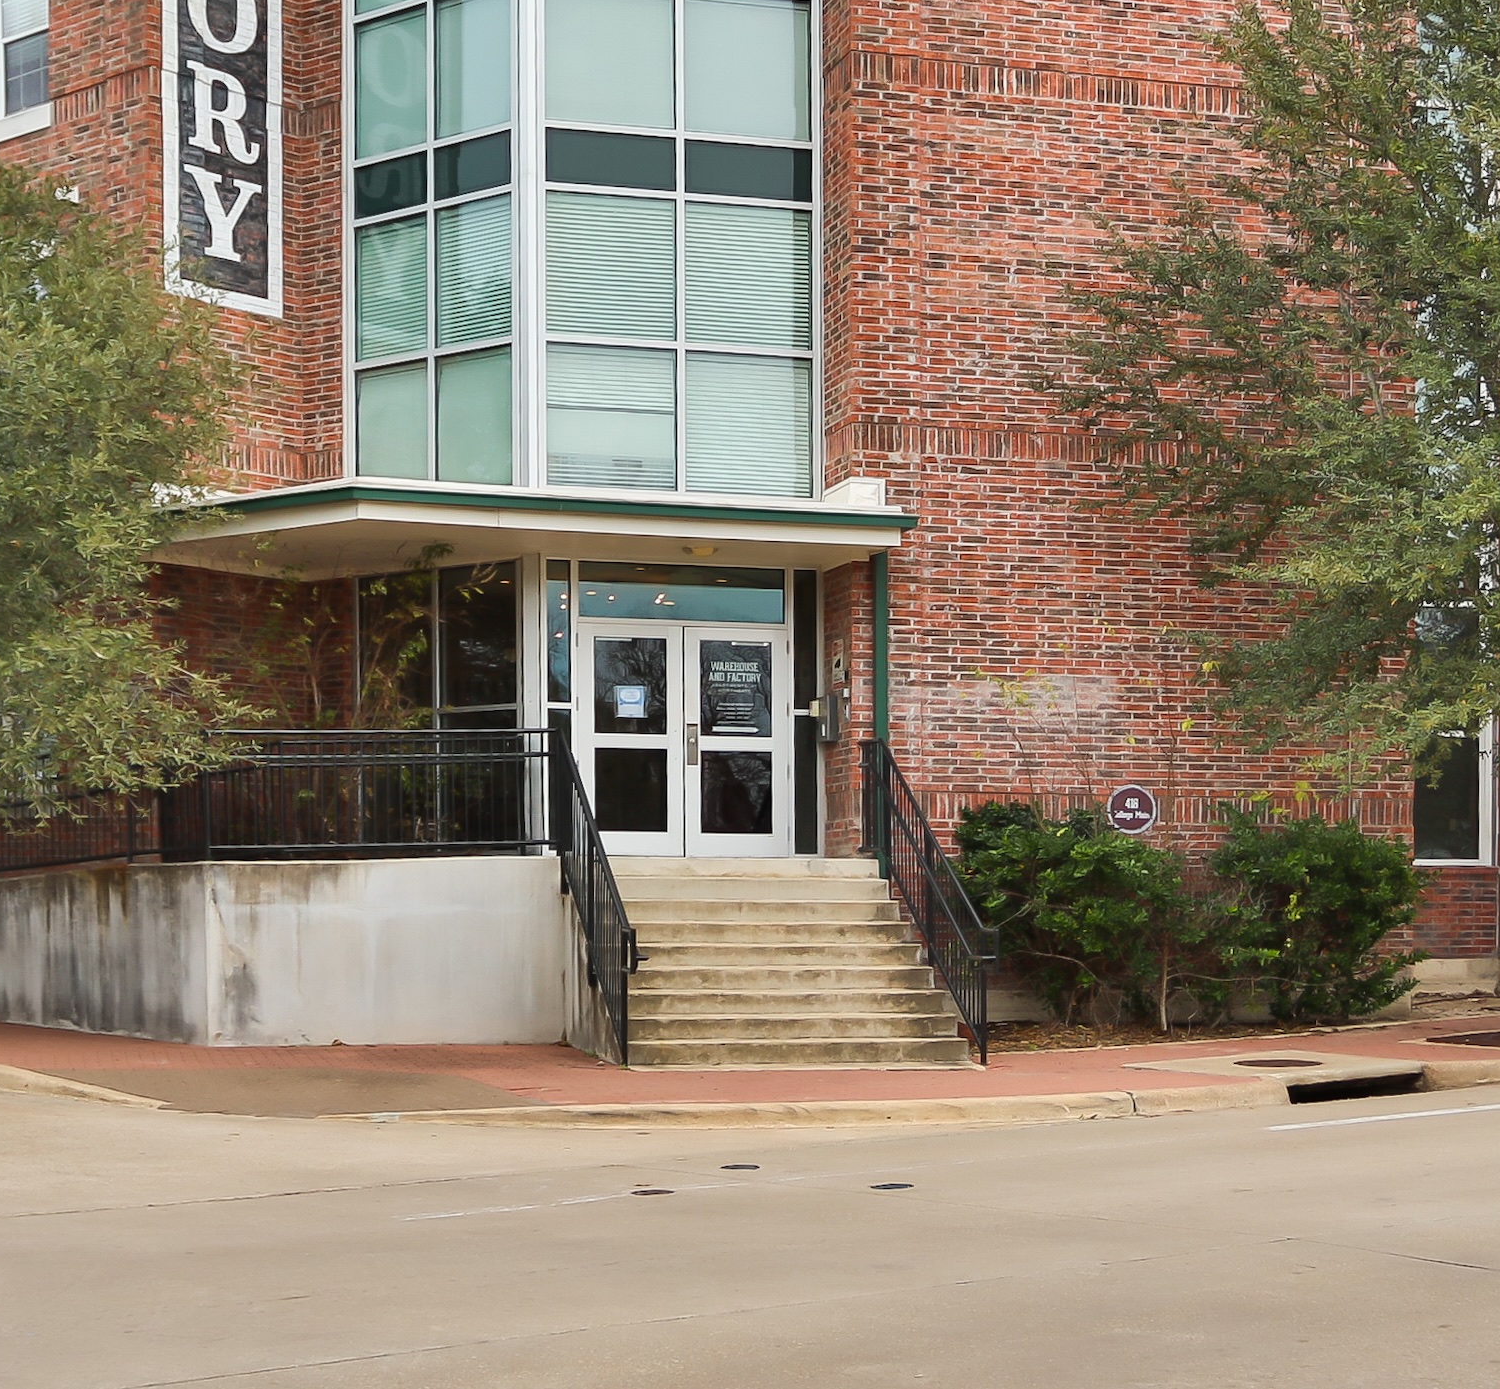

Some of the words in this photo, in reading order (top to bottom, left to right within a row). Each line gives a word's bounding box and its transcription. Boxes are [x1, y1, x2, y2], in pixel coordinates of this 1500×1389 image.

[710, 661, 759, 673] WAREHOUSE
[708, 672, 725, 682] AND
[726, 672, 761, 683] FACTORY
